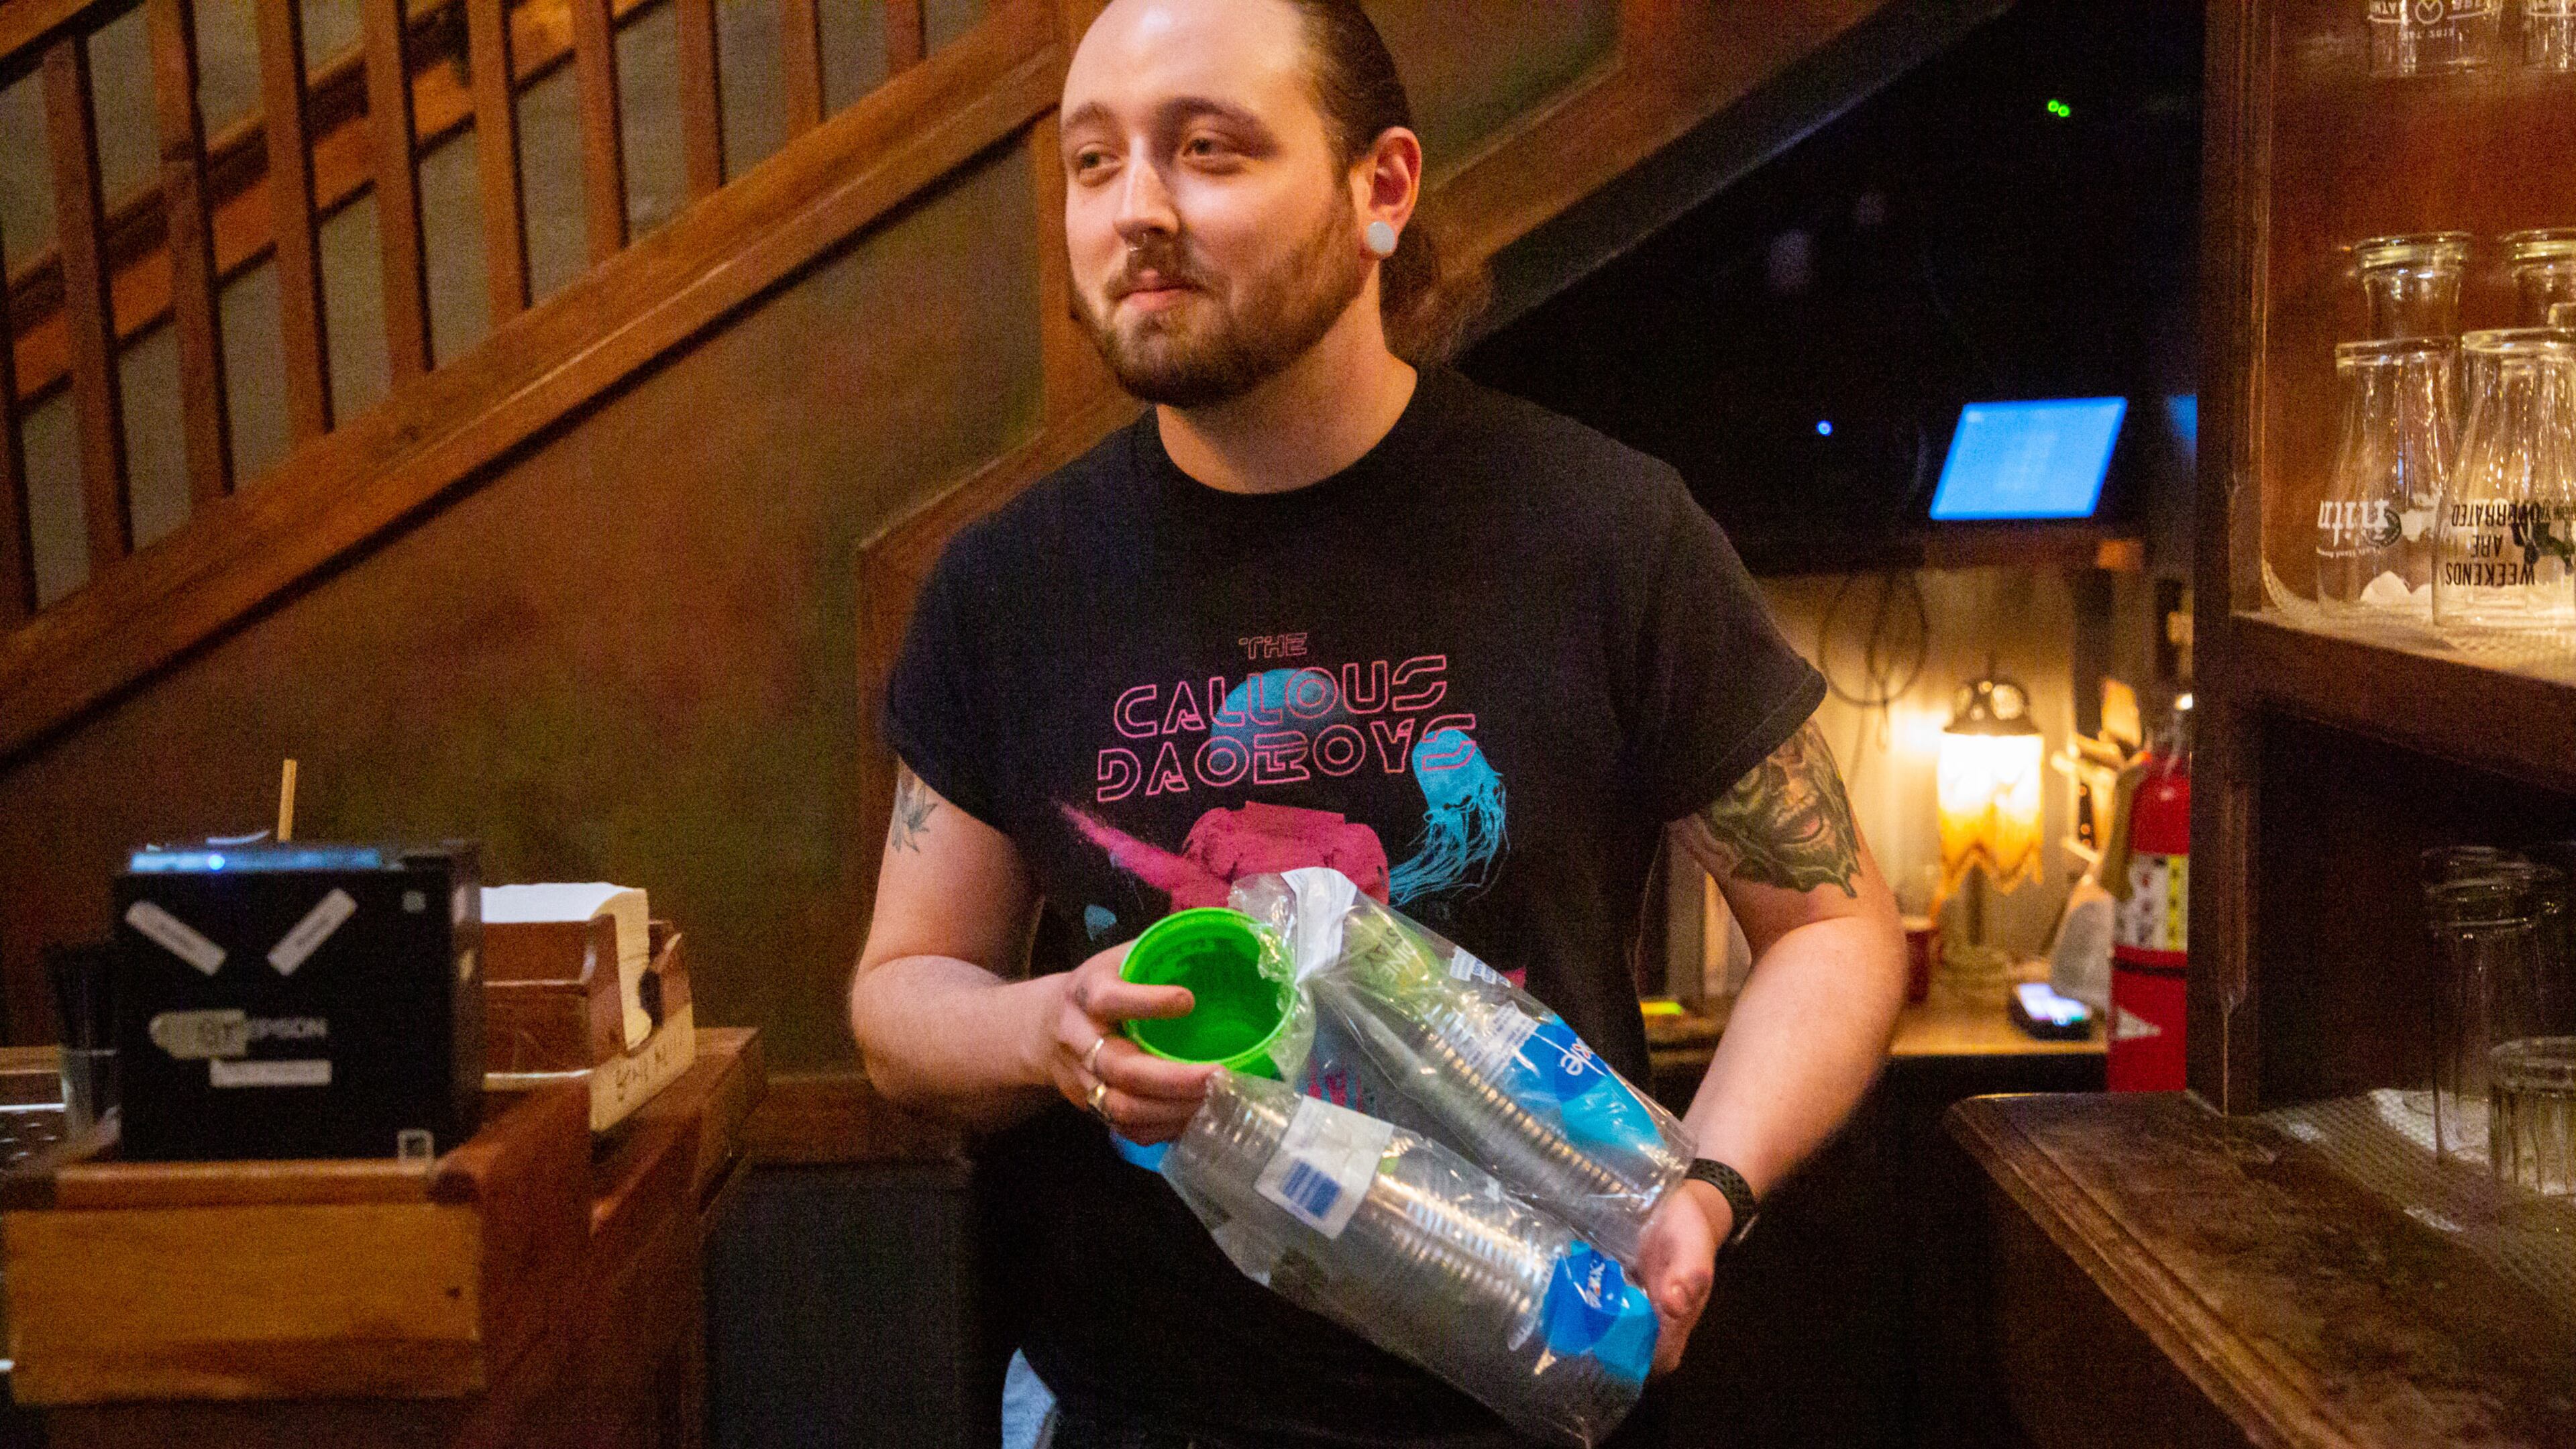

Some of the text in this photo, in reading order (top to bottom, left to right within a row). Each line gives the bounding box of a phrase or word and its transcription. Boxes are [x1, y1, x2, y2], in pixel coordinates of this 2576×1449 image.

[2471, 535, 2503, 557] ARE
[2445, 562, 2535, 586] WEEKENDS
[1238, 632, 1308, 659] THE
[1114, 655, 1447, 739] CALLOUS
